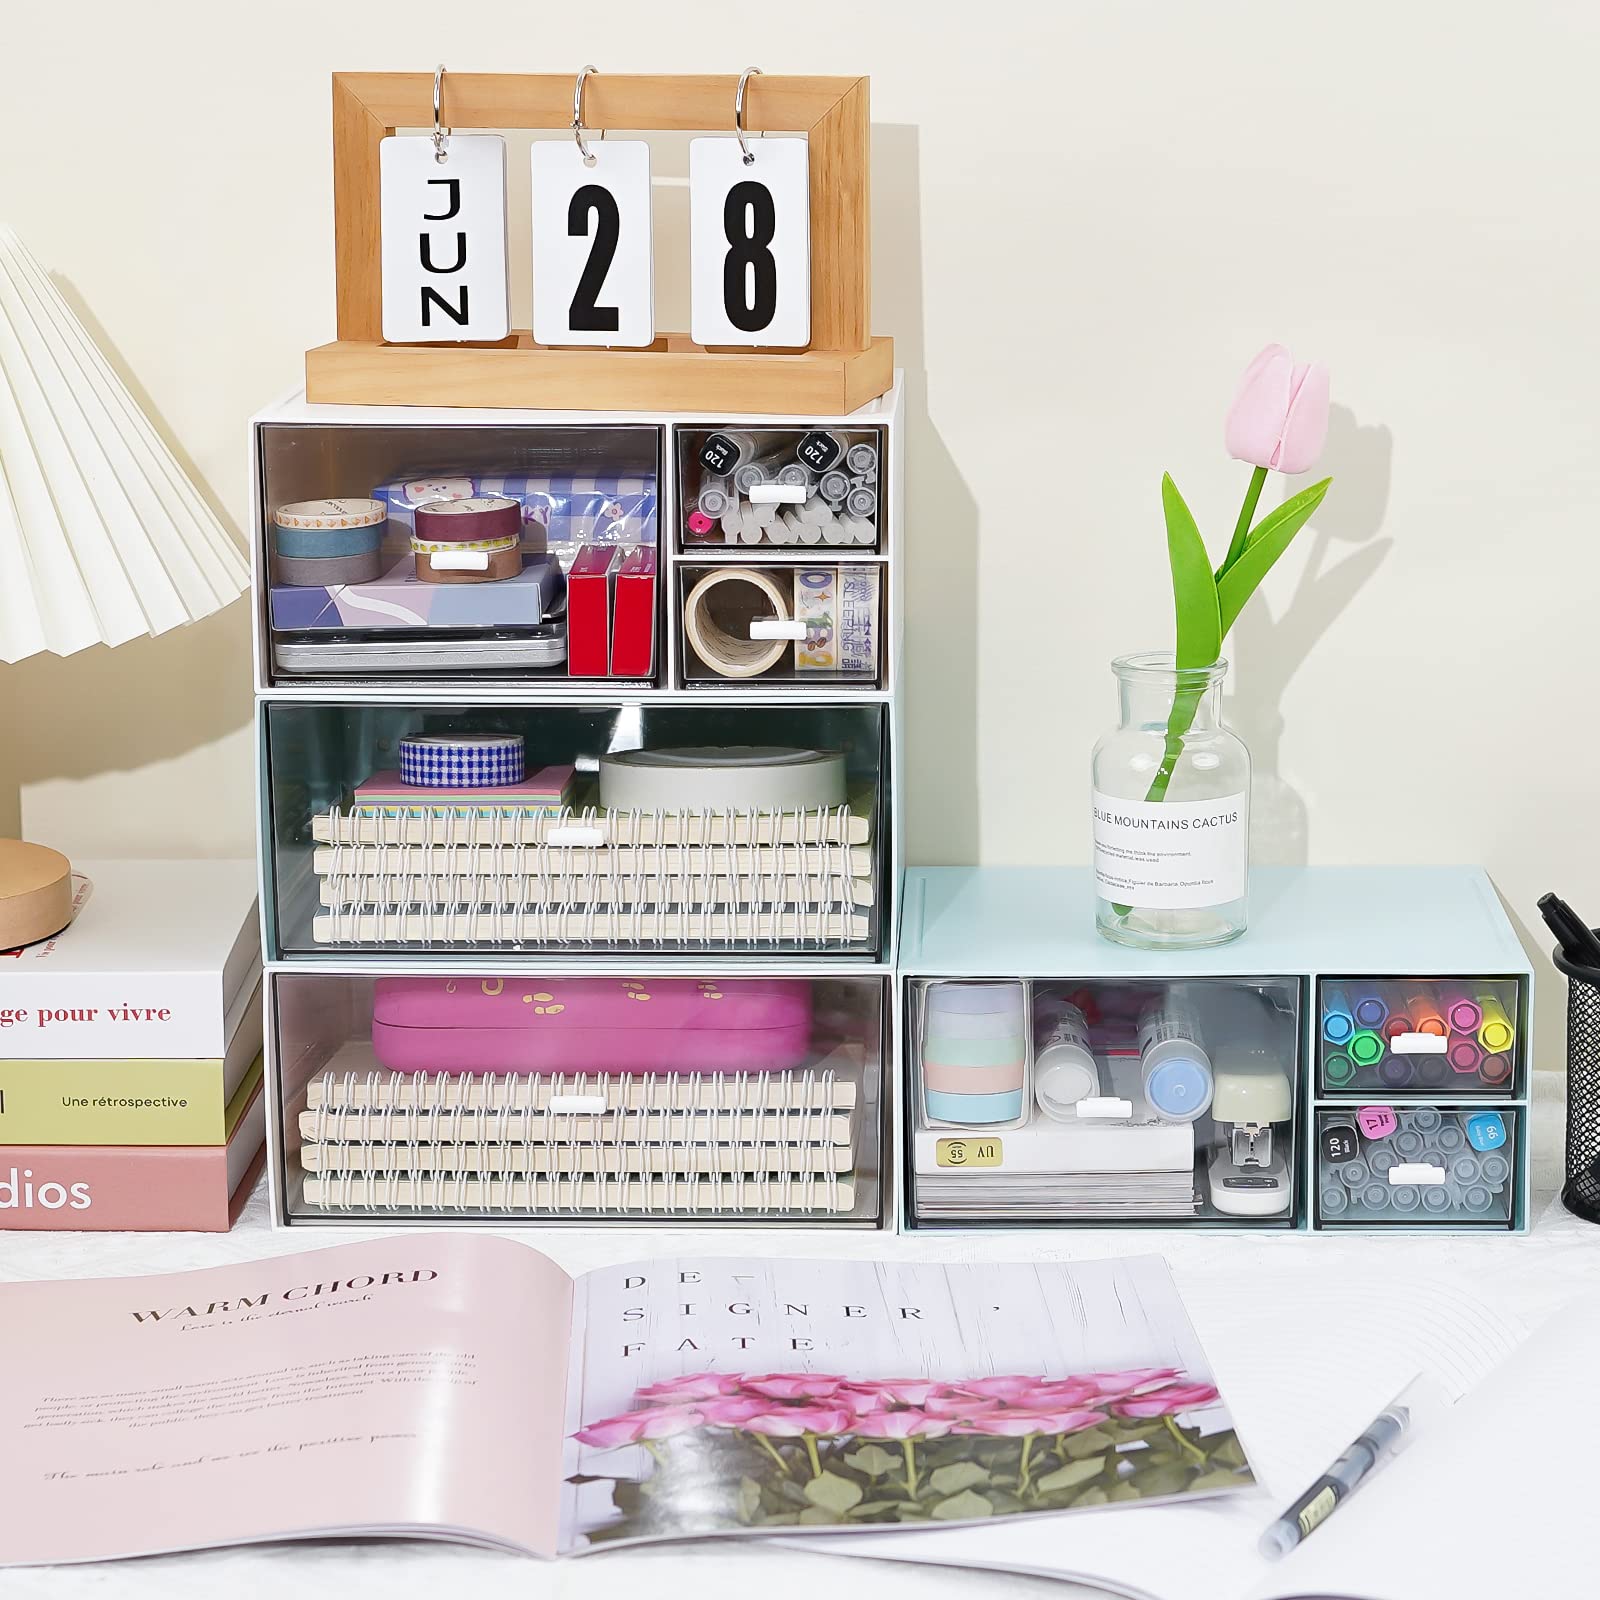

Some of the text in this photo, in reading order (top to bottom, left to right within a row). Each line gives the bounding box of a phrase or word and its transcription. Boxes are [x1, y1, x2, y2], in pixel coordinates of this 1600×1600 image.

[418, 178, 469, 327] JUN
[567, 184, 620, 332] 2
[723, 181, 777, 333] 8
[705, 450, 724, 469] 120
[804, 445, 824, 465] 120
[1093, 807, 1238, 830] BLUE MOUNTAINS CACTUS
[0, 1002, 173, 1028] ge pour vivre
[62, 1096, 188, 1109] Une rétrospective
[1366, 1118, 1379, 1131] 17
[950, 1145, 994, 1159] UV 55
[1330, 1137, 1341, 1158] 120
[0, 1167, 92, 1210] dios
[128, 1269, 439, 1323] WARM CHORD
